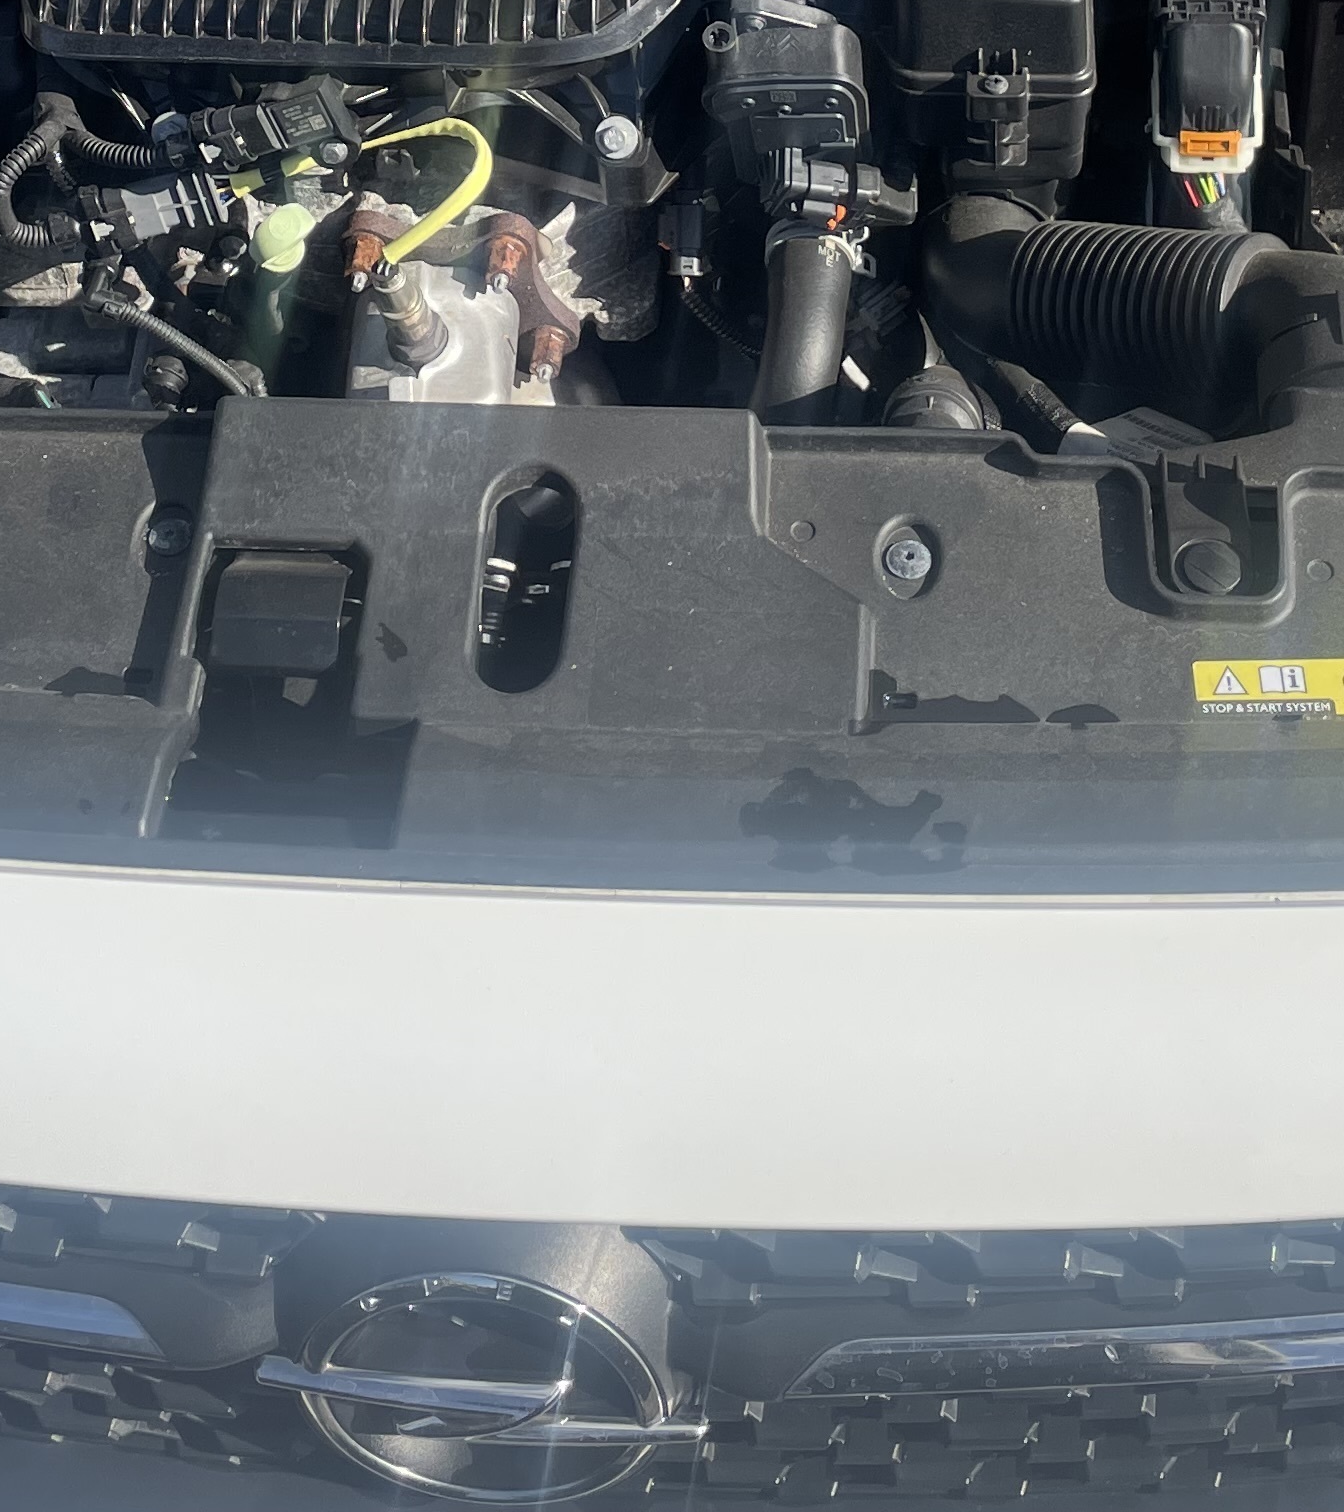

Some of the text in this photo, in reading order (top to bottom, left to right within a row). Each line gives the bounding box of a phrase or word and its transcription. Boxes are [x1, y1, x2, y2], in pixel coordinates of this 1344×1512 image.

[1202, 701, 1331, 714] STOP & START SYSTEM
